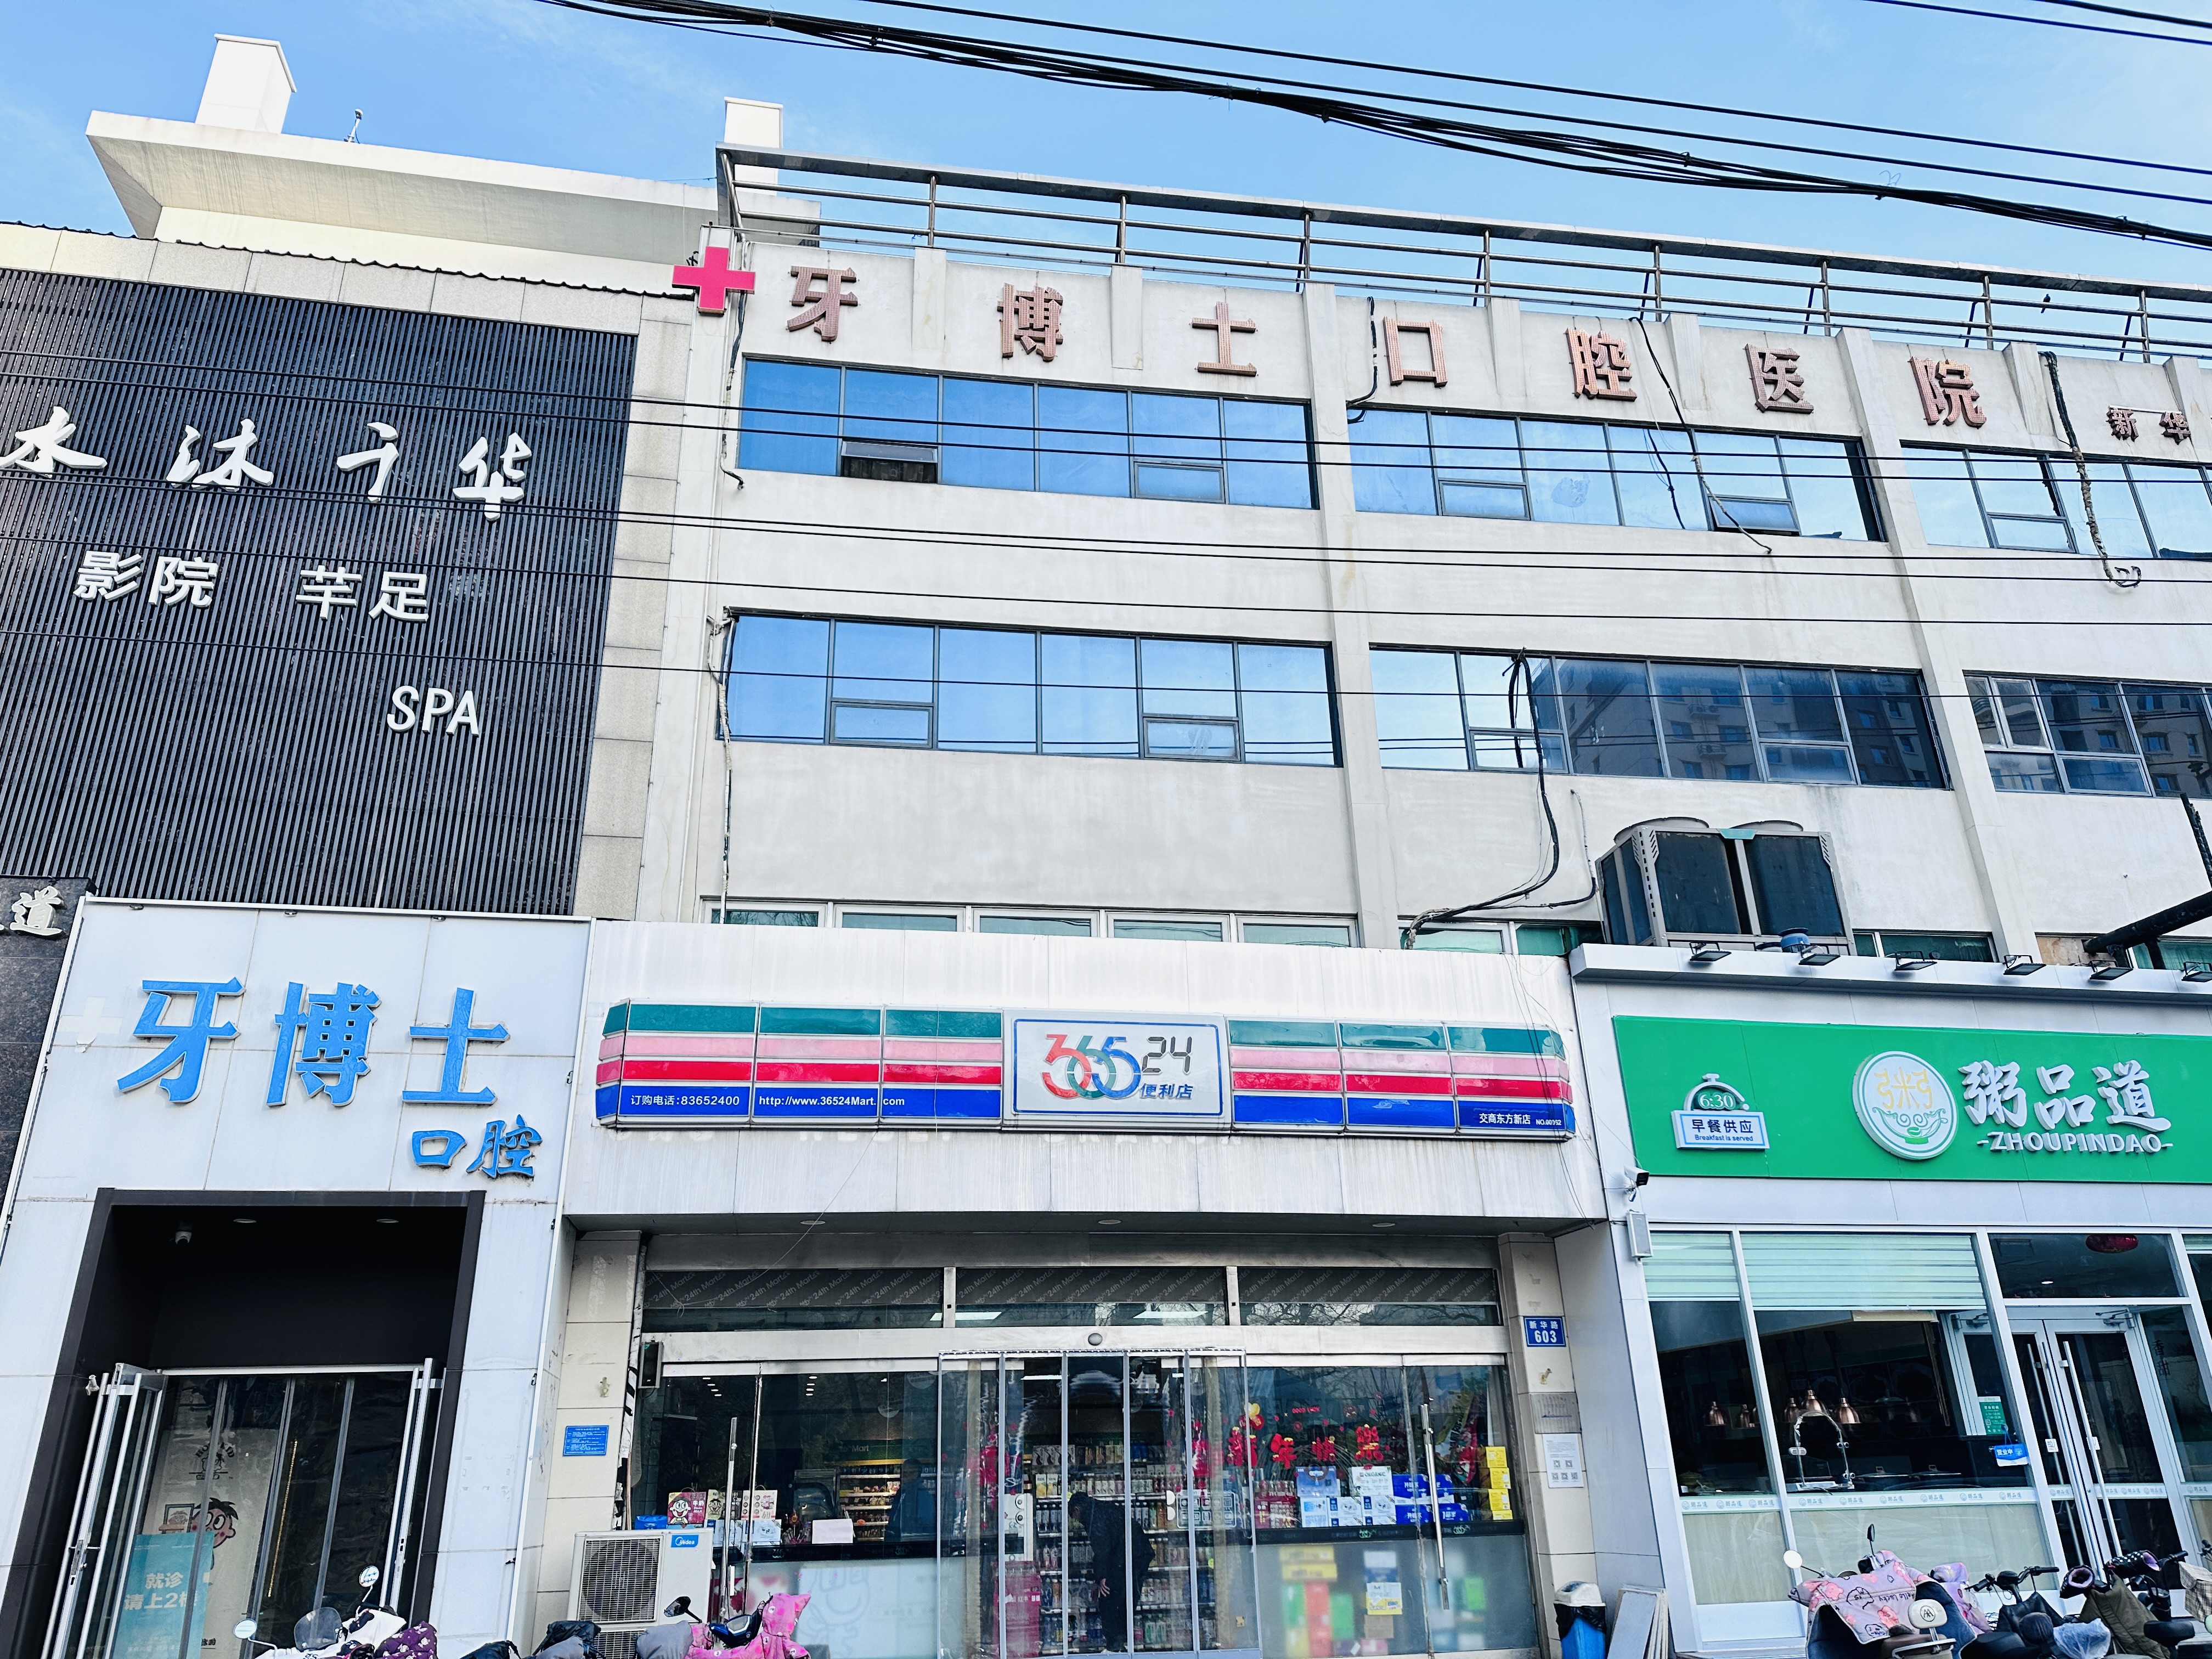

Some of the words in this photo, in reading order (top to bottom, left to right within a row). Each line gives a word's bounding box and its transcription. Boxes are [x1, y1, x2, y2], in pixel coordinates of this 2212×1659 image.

[787, 266, 1987, 428] 牙博士口腔医院
[2106, 408, 2191, 445] 新华
[72, 549, 218, 610] 影院
[387, 685, 480, 737] SPA
[0, 880, 65, 936] 道
[117, 977, 511, 1107] 牙博士
[630, 1094, 740, 1107] 订购电话:83652400
[1139, 1083, 1194, 1100] 便利店
[1700, 1094, 1734, 1108] 6:30
[1957, 1059, 2171, 1132] 粥品道
[1479, 1113, 1531, 1125] 交商东方新店
[1692, 1119, 1753, 1133] 早餐供应
[411, 1114, 543, 1180] 口腔
[653, 1288, 668, 1301] 24th
[670, 1274, 689, 1290] Mart
[685, 1286, 701, 1301] 24th
[701, 1274, 720, 1291] Mart
[719, 1286, 735, 1301] 24th
[734, 1273, 753, 1289] Mart
[749, 1286, 766, 1301] 24th
[766, 1273, 785, 1289] Mart
[780, 1285, 797, 1300] 24th
[795, 1273, 814, 1289] Mart
[812, 1286, 829, 1300] 24th
[828, 1273, 846, 1288] Mart
[844, 1285, 861, 1299] 24th
[860, 1273, 878, 1288] Mart
[874, 1285, 891, 1299] 24th
[890, 1272, 907, 1288] Mart
[904, 1285, 920, 1299] 24th
[919, 1272, 936, 1288] Mart
[1529, 1321, 1558, 1329] 新华路
[1534, 1330, 1557, 1343] 603
[145, 1571, 184, 1589] 就诊
